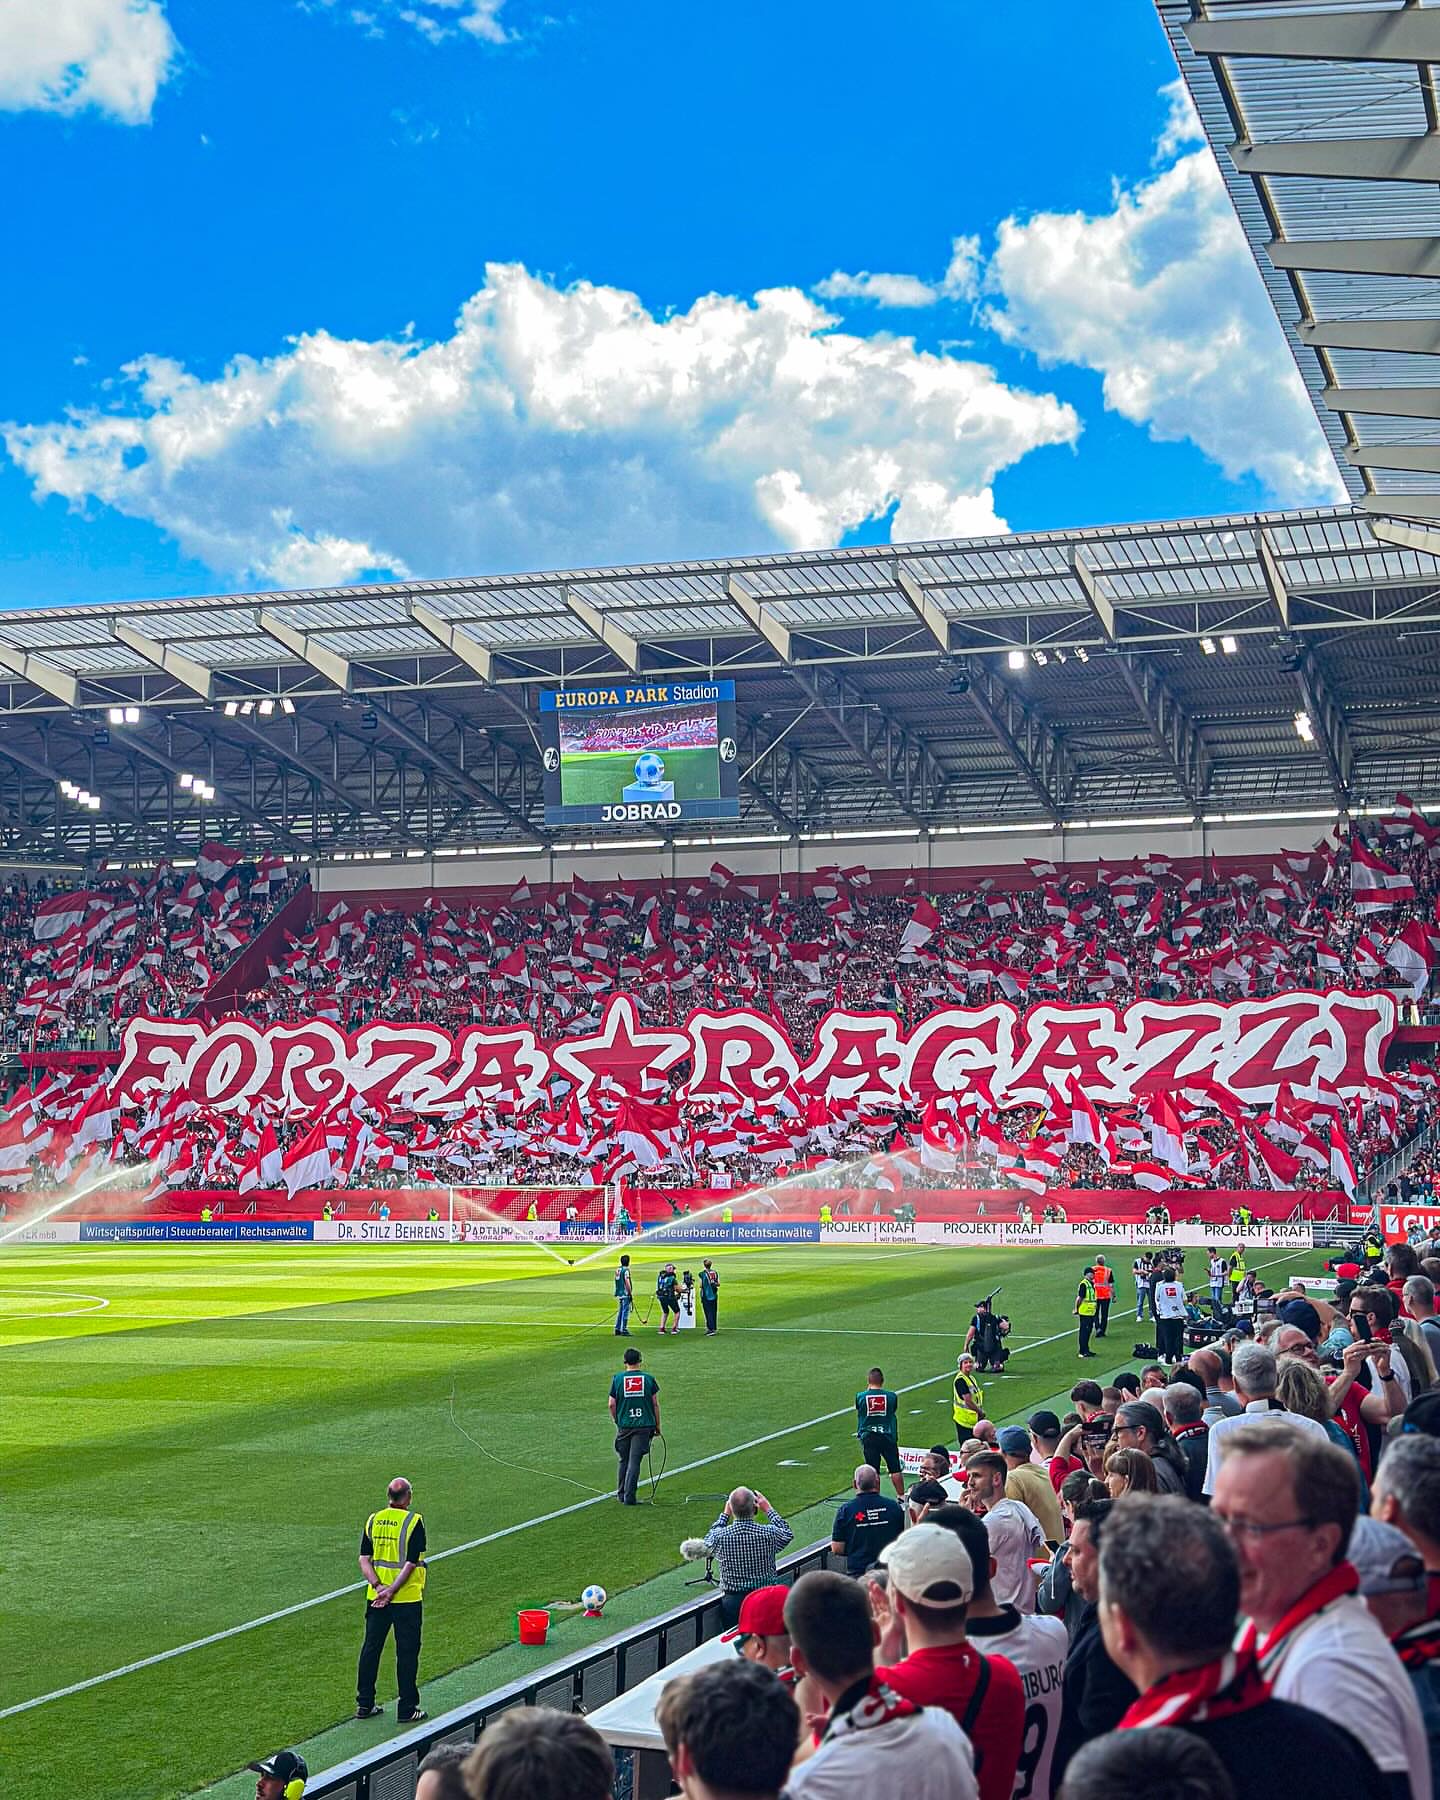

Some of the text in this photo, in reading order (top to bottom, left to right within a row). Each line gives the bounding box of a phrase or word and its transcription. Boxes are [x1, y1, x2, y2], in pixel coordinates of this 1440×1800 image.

[555, 685, 719, 707] EUROPA PARK Stadion
[601, 803, 682, 821] JOBRAD
[107, 989, 1397, 1115] FORZA RAGAZZI
[820, 1222, 916, 1233] PROJEKT KRAFT
[943, 1223, 1043, 1234] PROJEKT KRAFT
[1072, 1224, 1176, 1235] PROJEKT KRAFT
[1403, 1214, 1440, 1234] GU
[86, 1225, 307, 1238] Wirtschaftsprüfer Steuerberater Rechtsanwälte
[661, 1227, 730, 1238] Steuerberater
[738, 1227, 813, 1238] Rechtsanwälte
[1204, 1225, 1262, 1237] PROJEKT
[629, 1408, 642, 1418] 18
